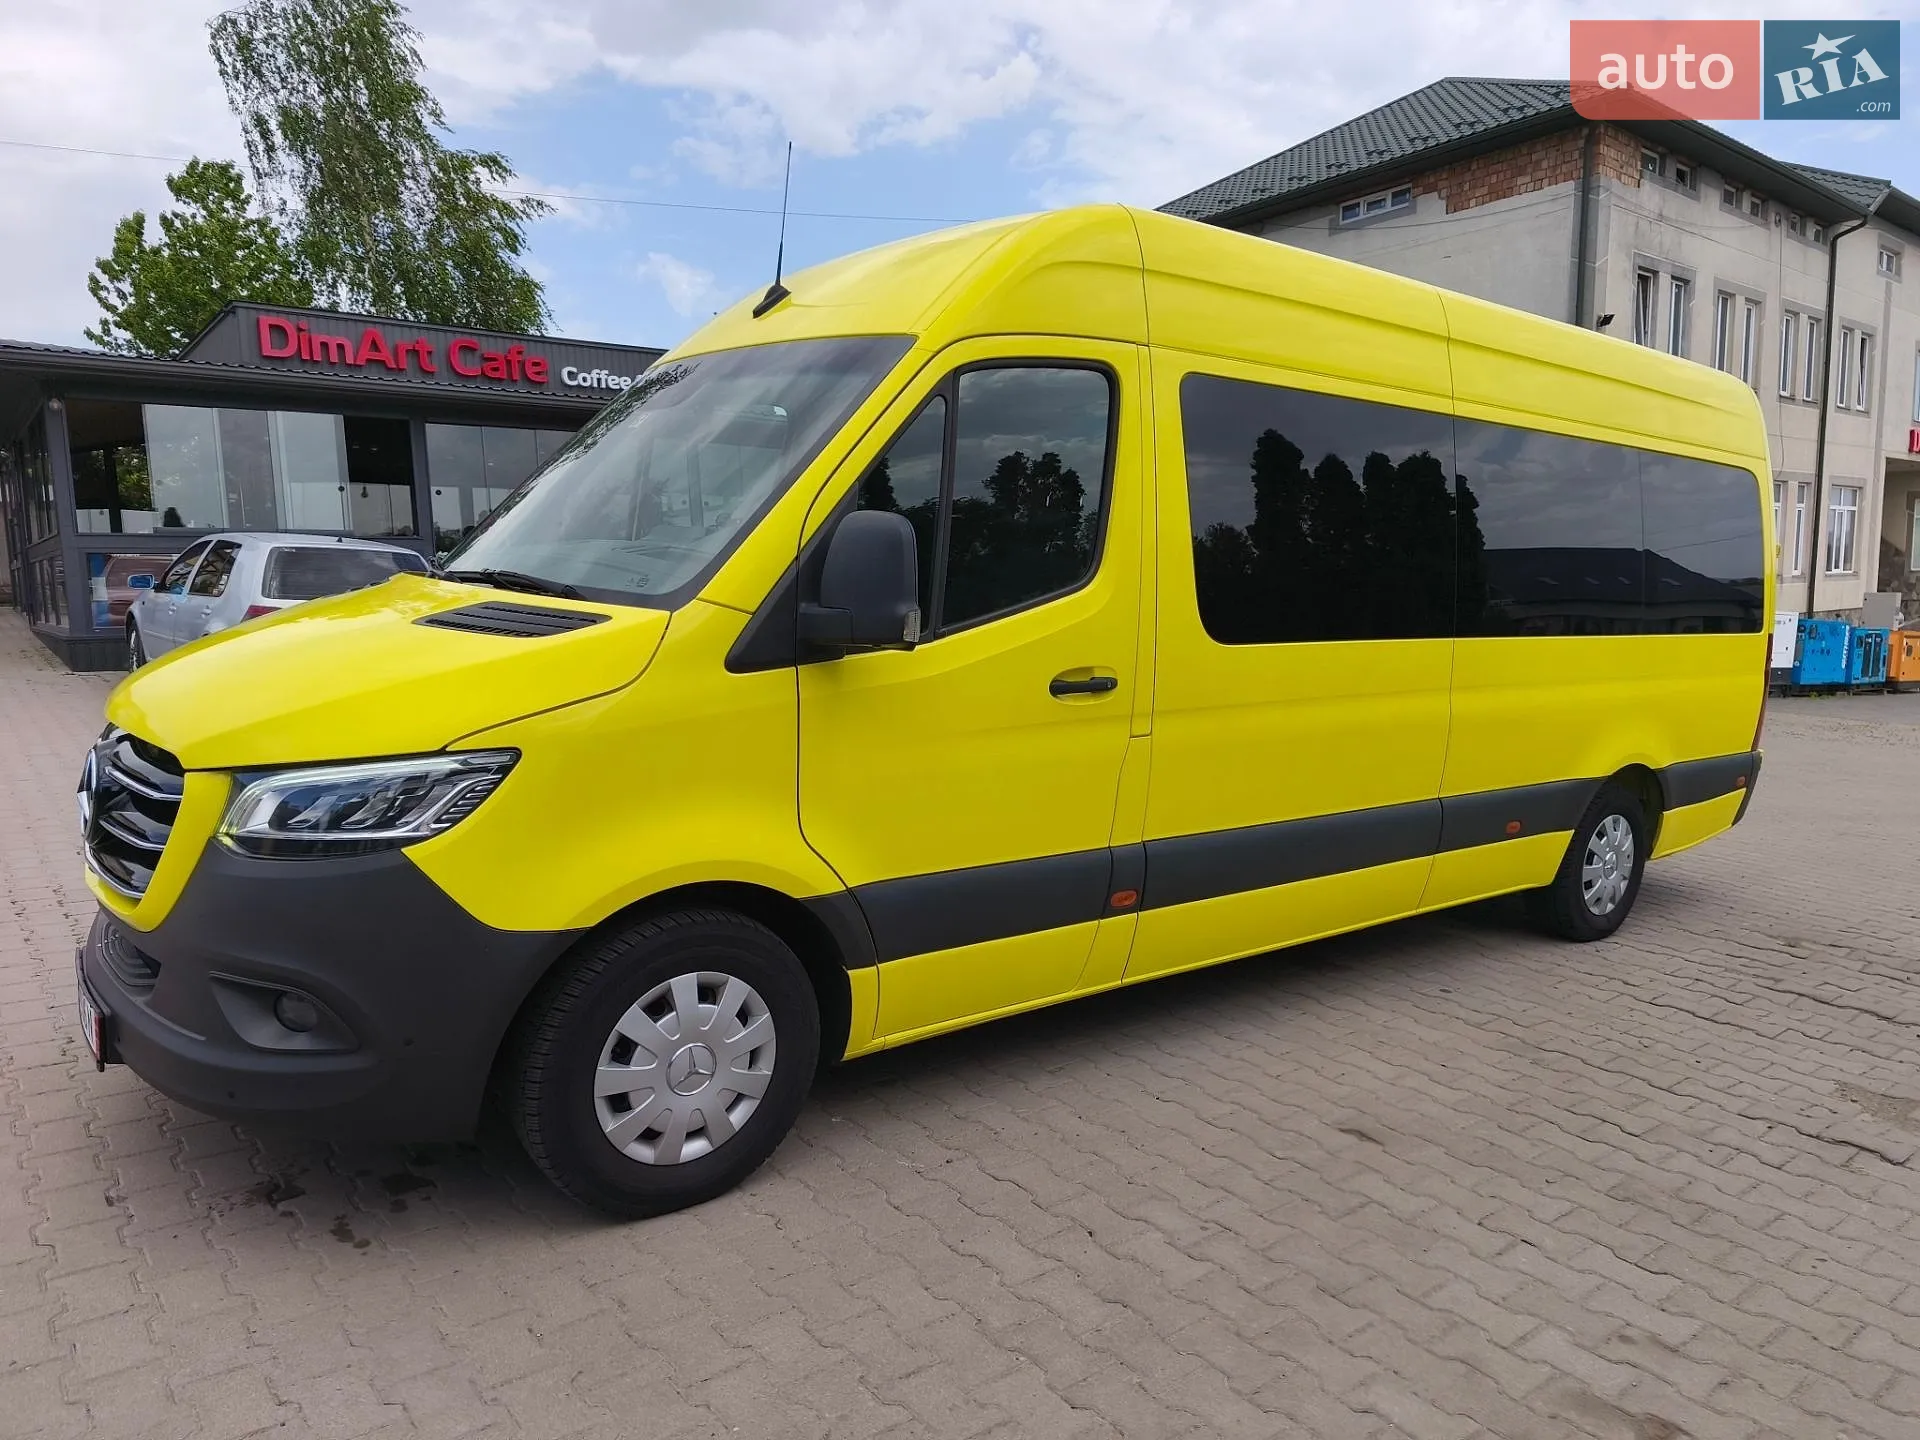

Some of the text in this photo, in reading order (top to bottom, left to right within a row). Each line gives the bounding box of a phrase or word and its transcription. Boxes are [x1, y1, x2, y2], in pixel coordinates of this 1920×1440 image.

[257, 315, 548, 384] DimArt Cafe
[561, 366, 631, 390] Coffee
